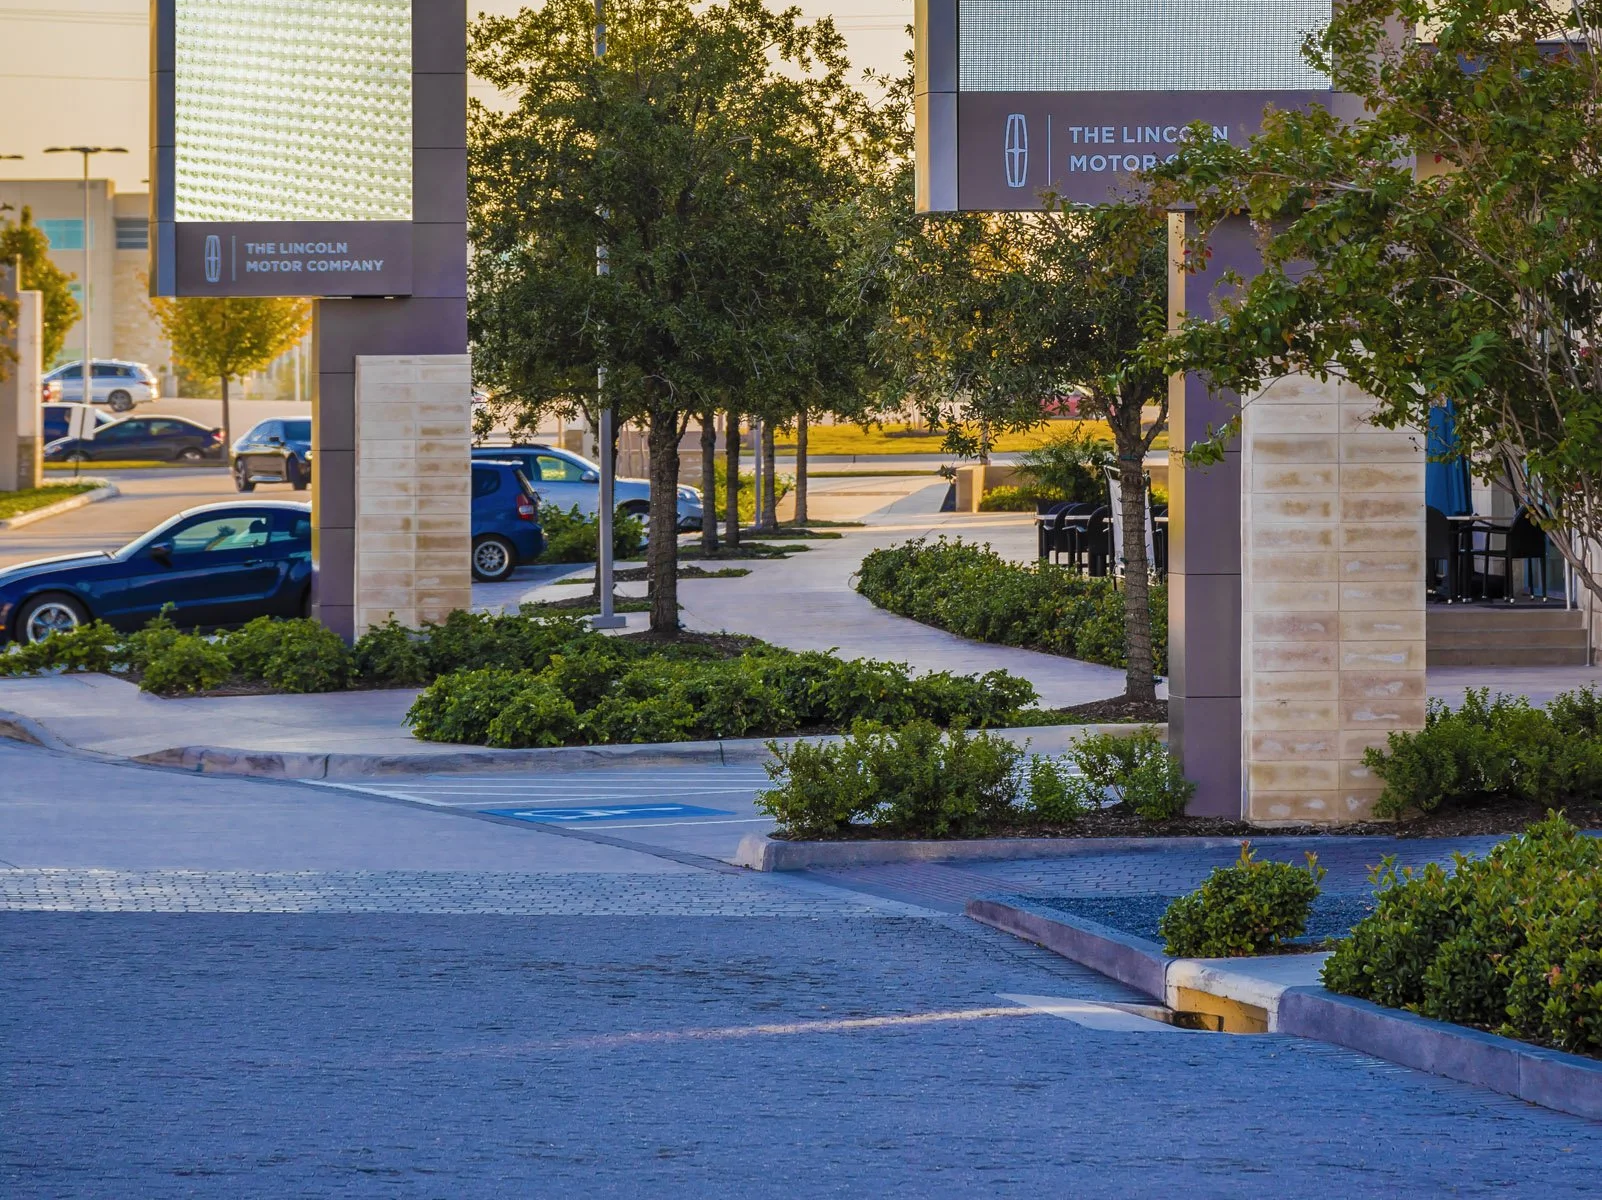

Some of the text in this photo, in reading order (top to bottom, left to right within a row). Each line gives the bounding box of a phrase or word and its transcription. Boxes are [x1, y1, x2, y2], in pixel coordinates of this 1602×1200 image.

[1068, 125, 1229, 144] THE LINCON
[1070, 154, 1158, 172] MOTOR
[244, 242, 348, 255] THE LINCOLN
[245, 260, 385, 273] MOTOR COMPANY
